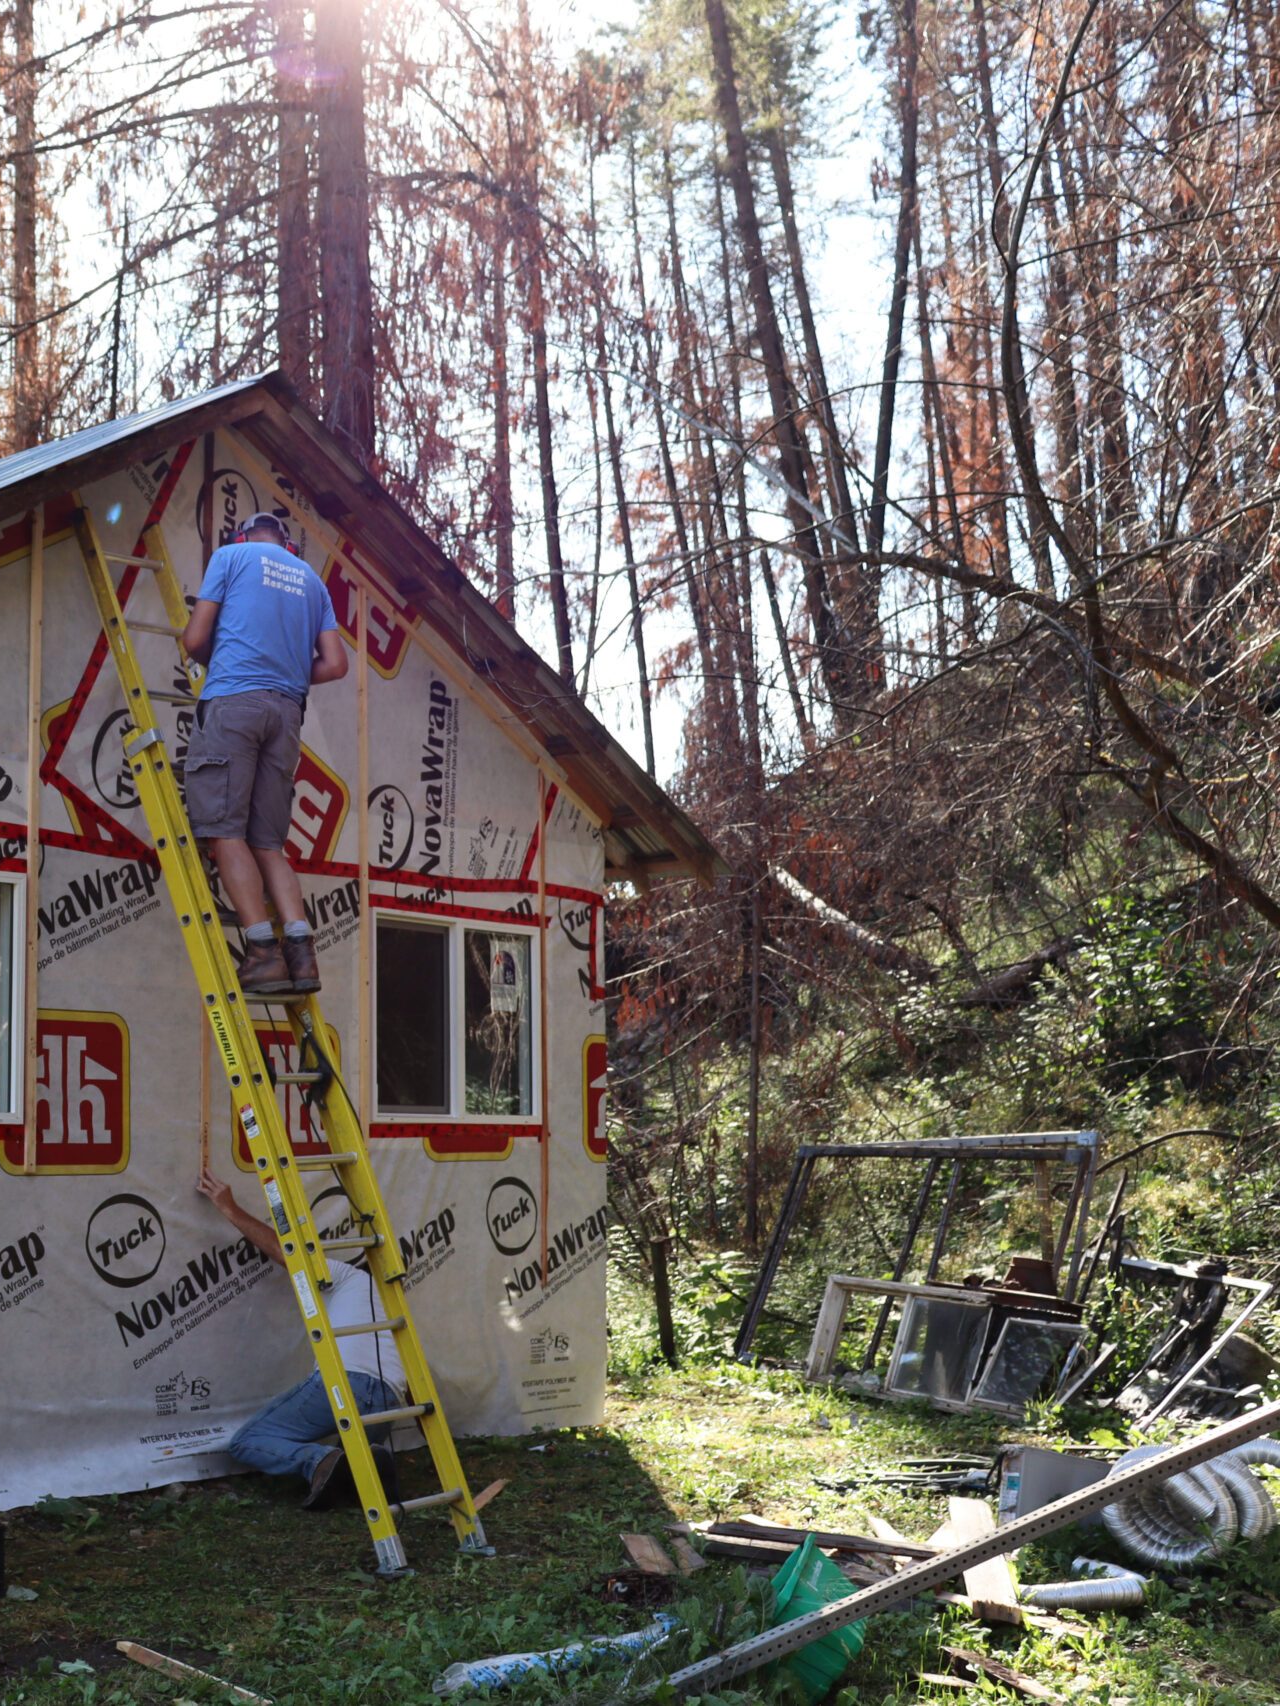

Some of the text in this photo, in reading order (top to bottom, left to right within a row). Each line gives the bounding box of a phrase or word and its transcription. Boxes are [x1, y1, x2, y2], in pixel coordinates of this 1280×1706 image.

[262, 576, 305, 597] Restore.
[263, 565, 306, 587] Rebuild.
[378, 793, 395, 865] Tuck
[49, 894, 148, 949] Premium Building Wrap
[54, 898, 161, 961] de bâtiment haut de gamme
[211, 1010, 237, 1068] FEATHERLITE
[492, 1196, 530, 1239] Tuck
[96, 1216, 156, 1268] Tuck
[0, 1298, 12, 1313] de
[14, 1278, 45, 1307] gamme
[4, 1274, 30, 1296] Wrap
[171, 1261, 261, 1329] Premium Building Wrap
[133, 1265, 274, 1369] Enveloppe de bâtiment haut de gamme
[156, 1384, 177, 1393] CCMC
[140, 1432, 177, 1444] INTERTAPE
[179, 1428, 211, 1439] POLYMER
